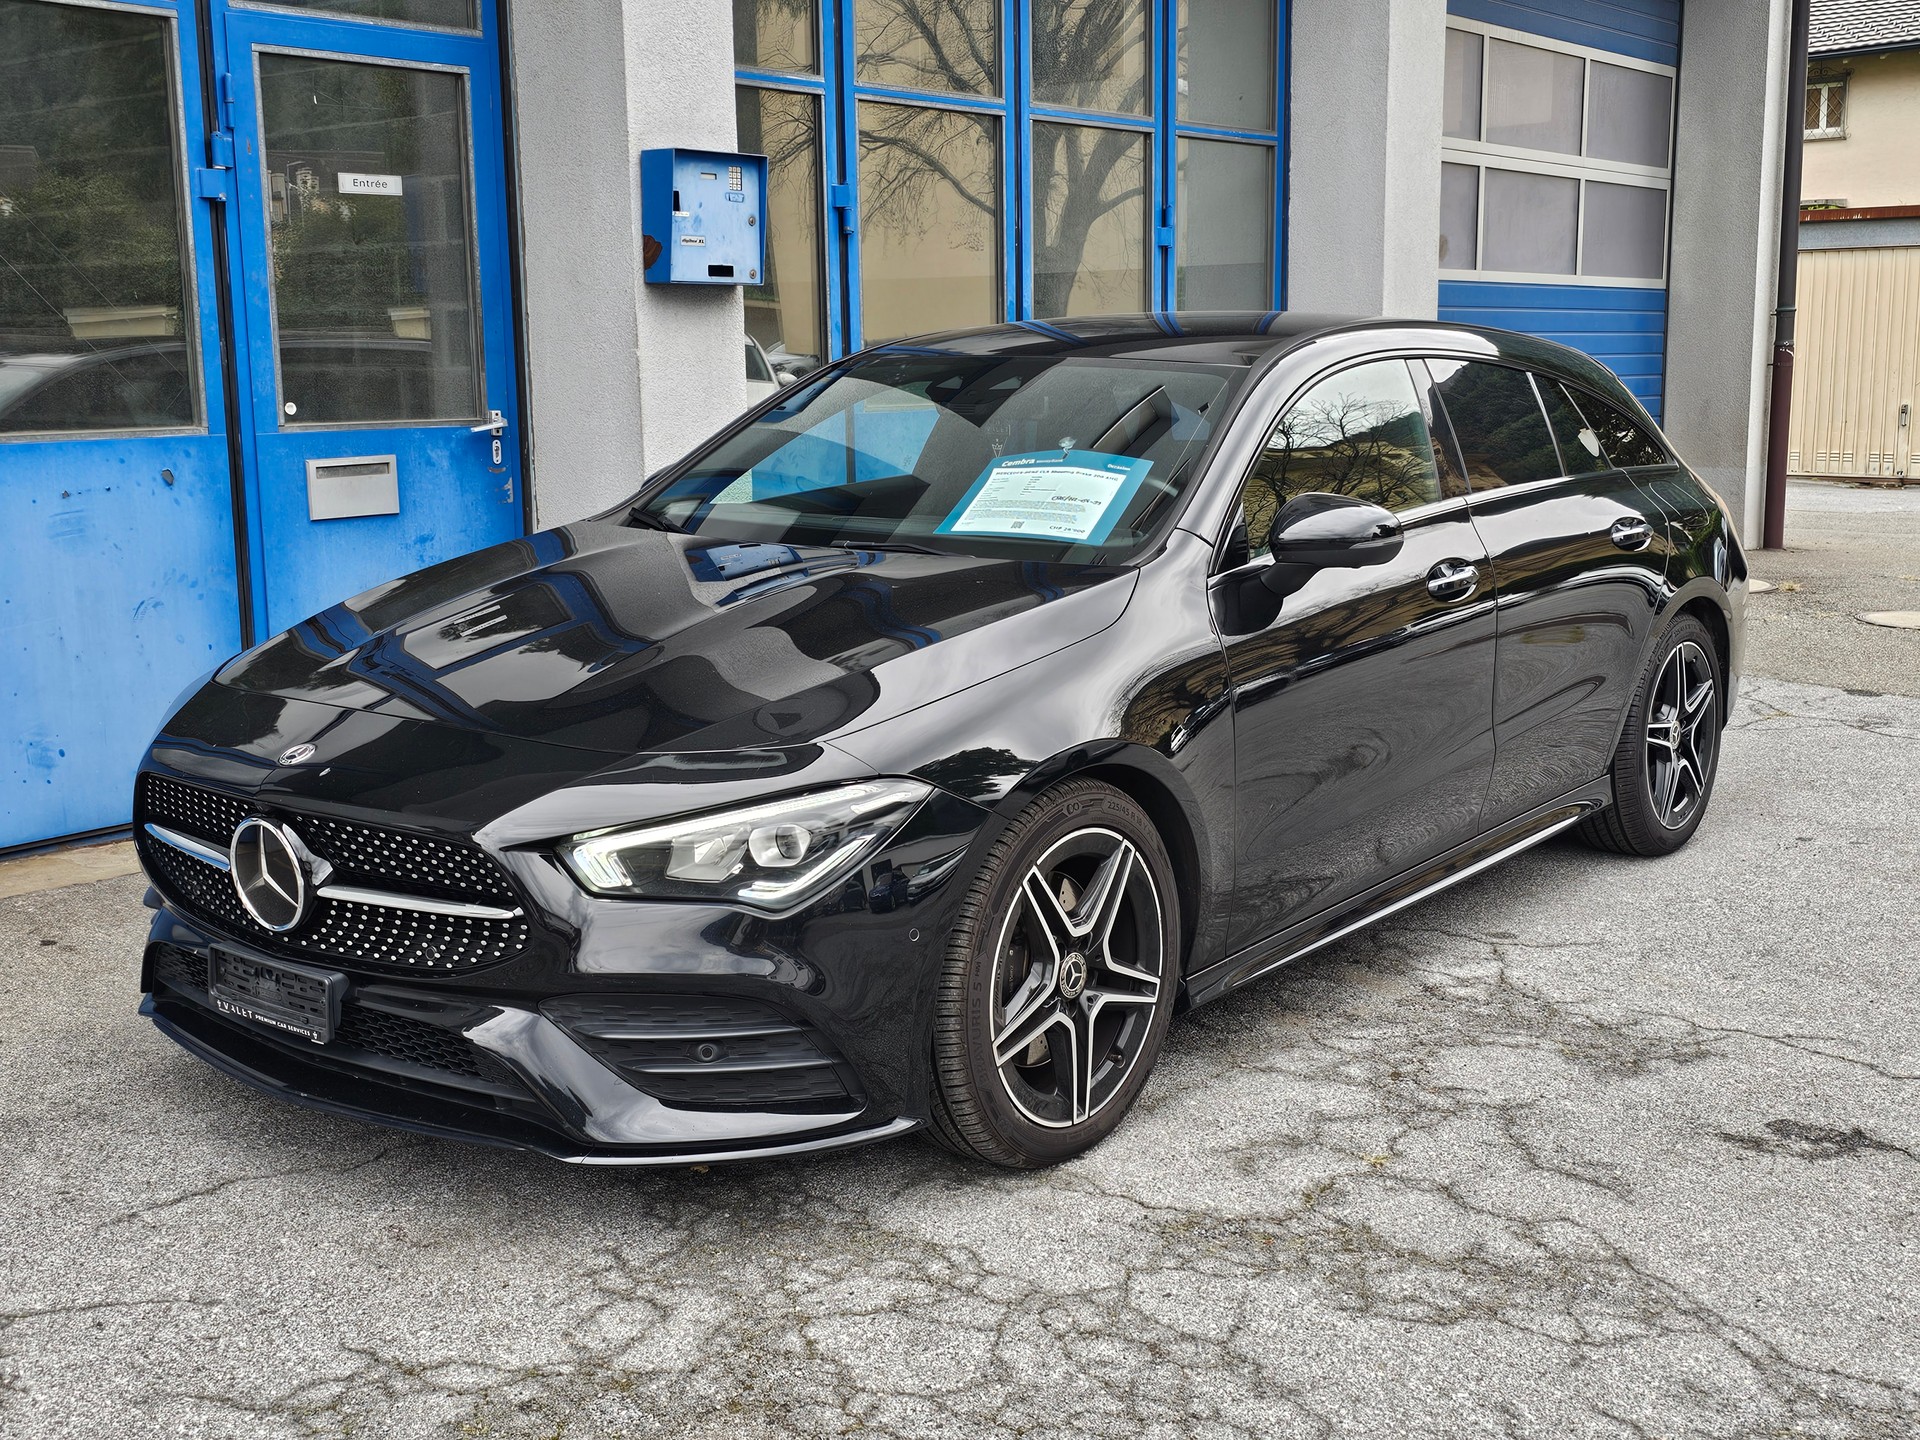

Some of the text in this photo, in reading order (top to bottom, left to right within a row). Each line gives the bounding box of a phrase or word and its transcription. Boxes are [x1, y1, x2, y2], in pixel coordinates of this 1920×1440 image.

[352, 178, 388, 189] Entrée
[1001, 458, 1036, 467] Cembra
[1107, 800, 1130, 817] 225/45
[222, 1001, 311, 1038] VALET PREMIUM CAR SERVICES
